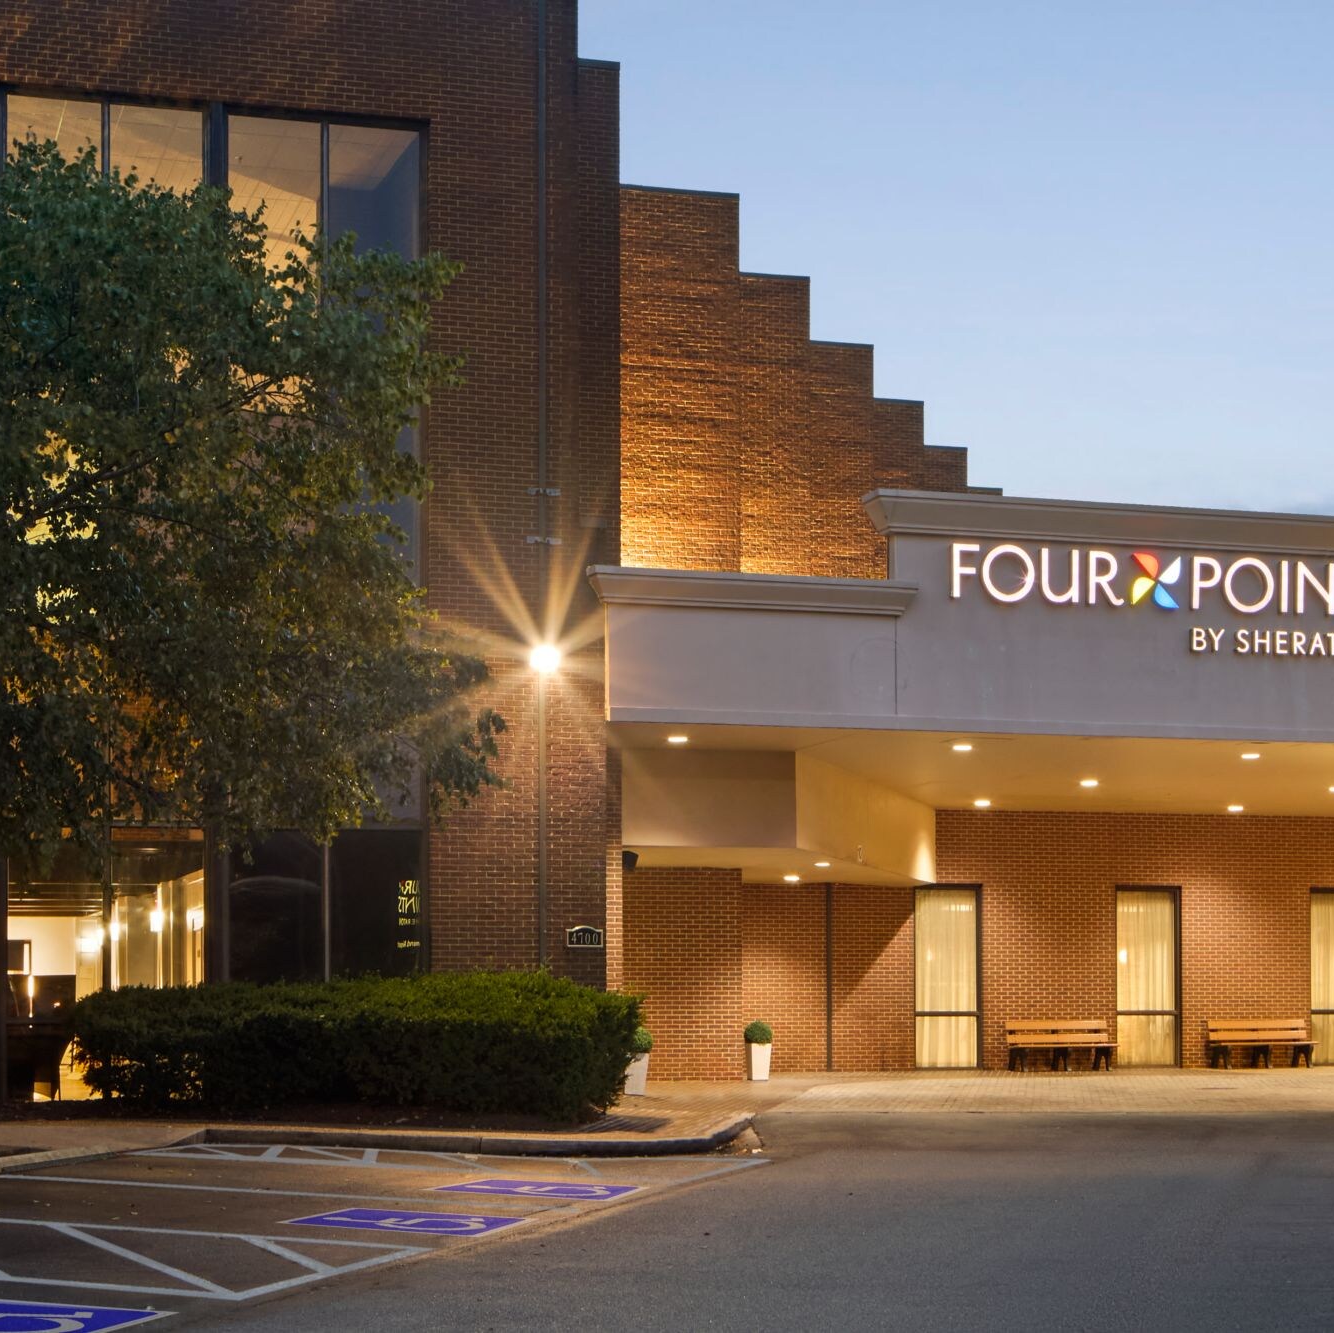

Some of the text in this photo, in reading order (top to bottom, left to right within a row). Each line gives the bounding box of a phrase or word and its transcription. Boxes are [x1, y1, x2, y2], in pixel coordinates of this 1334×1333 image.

[951, 542, 1125, 606] FOUR
[1192, 627, 1225, 651] BY
[571, 932, 599, 945] 4700
